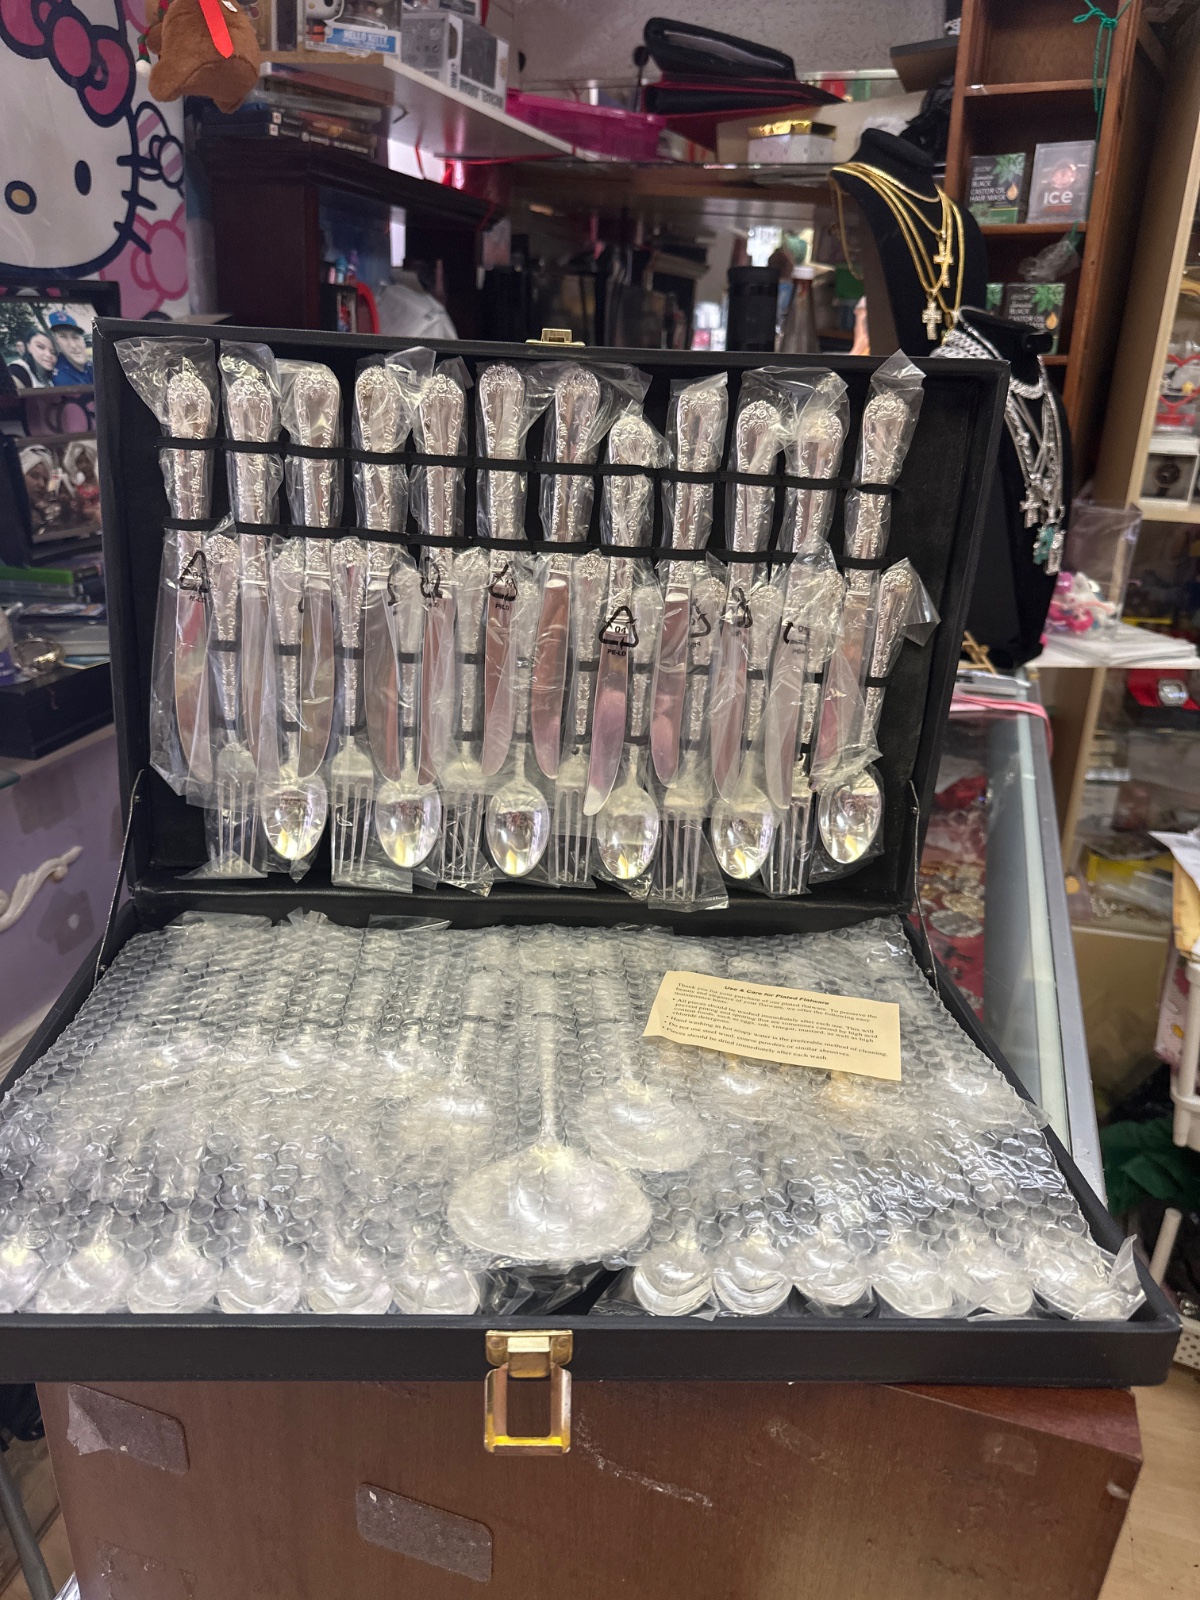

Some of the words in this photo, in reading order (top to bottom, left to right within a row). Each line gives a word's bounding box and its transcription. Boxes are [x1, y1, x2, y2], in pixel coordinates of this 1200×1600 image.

[614, 625, 627, 635] 04
[607, 648, 627, 657] PE-LD
[799, 997, 829, 1005] Flatware
[824, 1012, 854, 1021] following
[688, 1020, 714, 1028] washing
